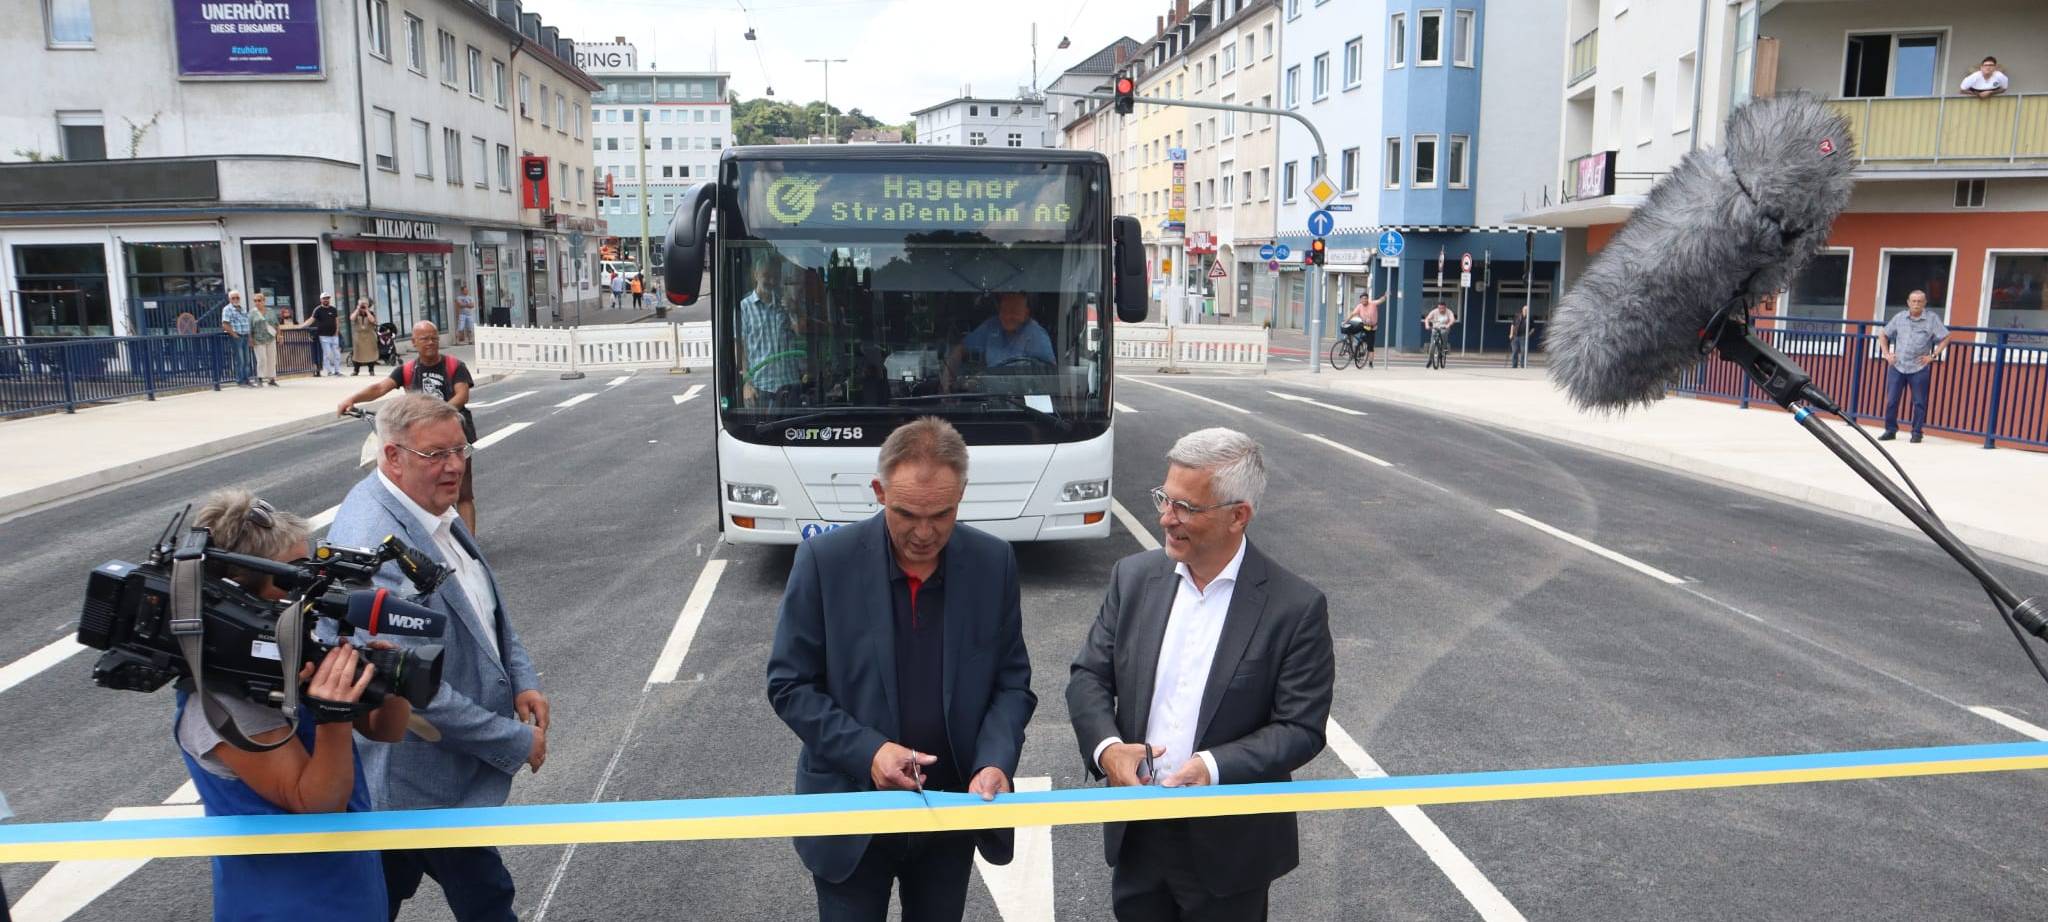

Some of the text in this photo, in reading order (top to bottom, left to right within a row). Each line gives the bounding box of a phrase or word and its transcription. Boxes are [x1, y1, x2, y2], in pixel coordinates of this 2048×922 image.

[202, 0, 290, 20] UNERHÖRT!
[210, 24, 286, 33] DIESE EINSAMEN.
[883, 175, 1019, 200] Hagener
[831, 202, 1072, 222] Straßenbahn AG
[376, 219, 412, 239] MIKADO
[832, 427, 863, 440] 758
[388, 613, 424, 630] WDR
